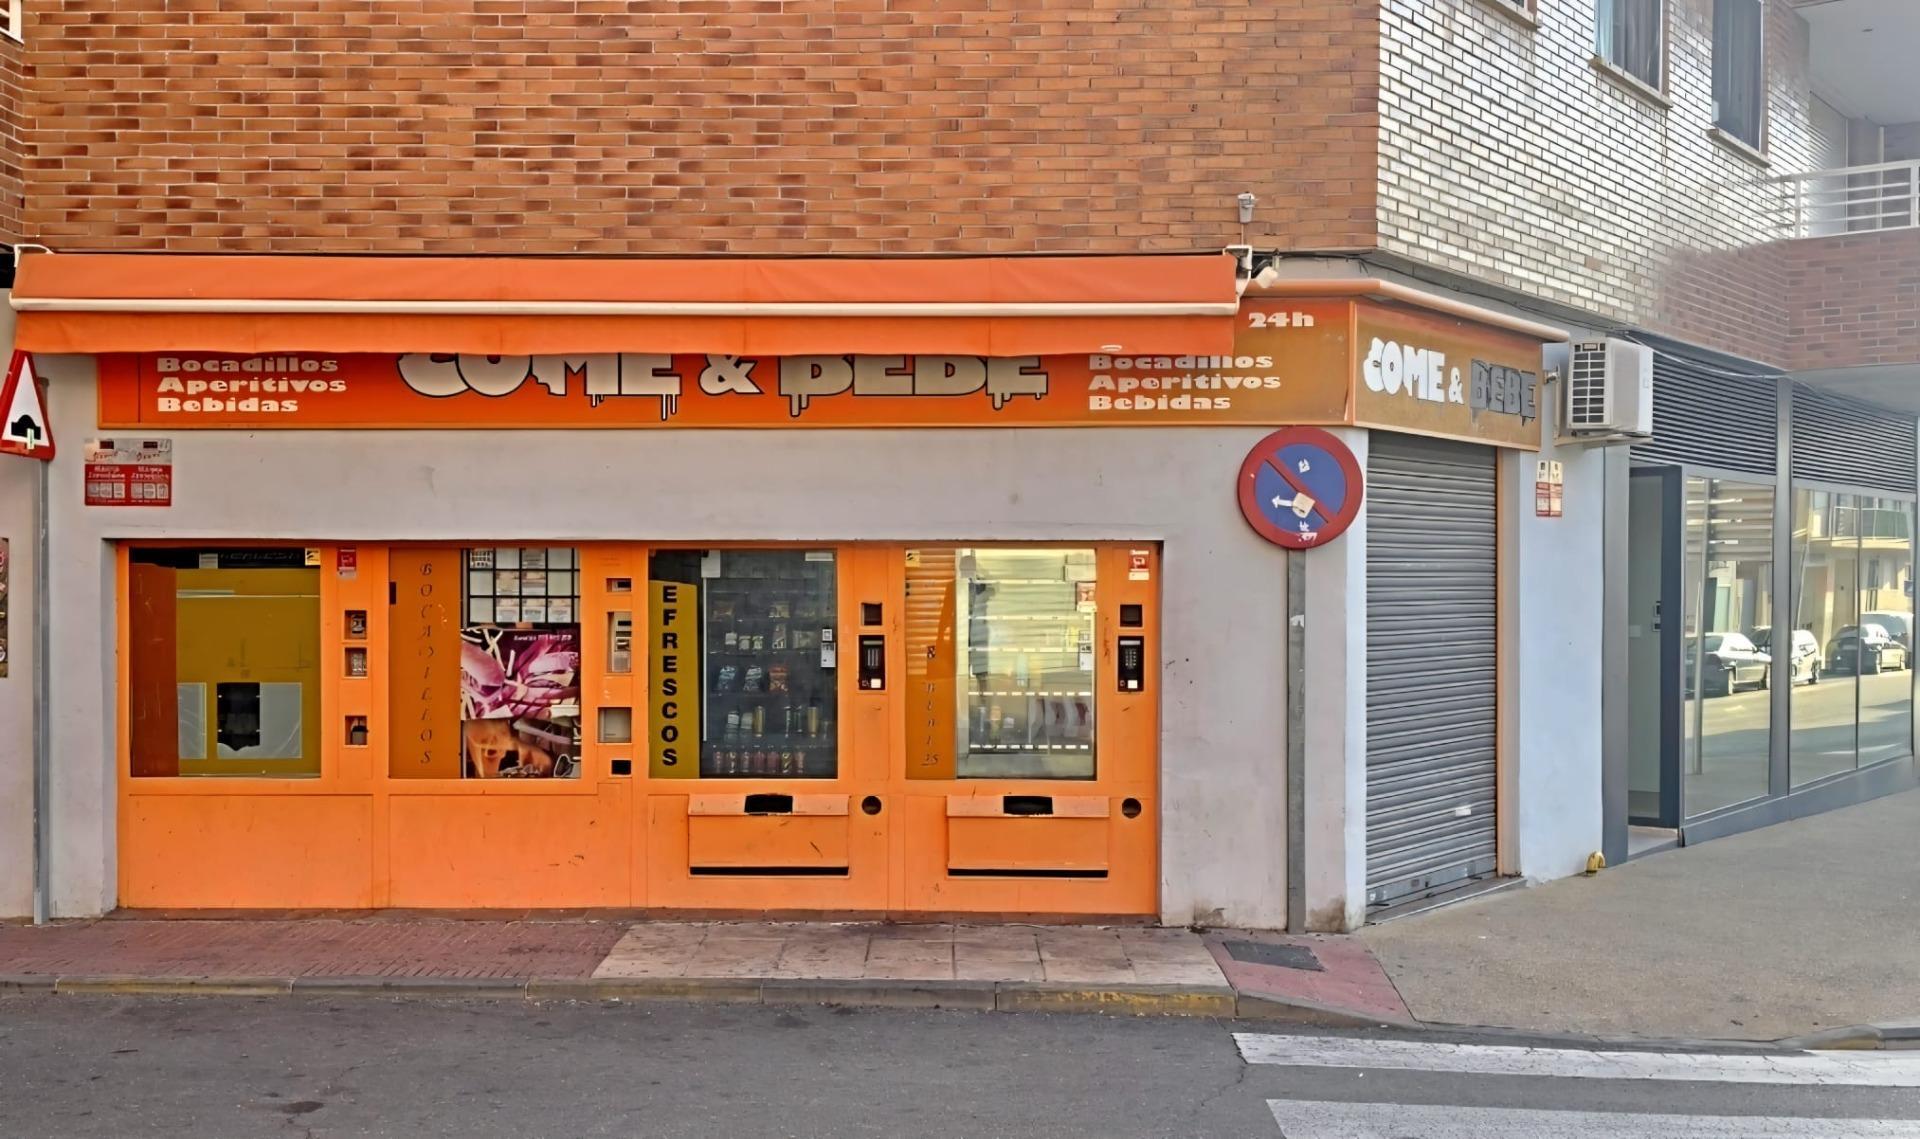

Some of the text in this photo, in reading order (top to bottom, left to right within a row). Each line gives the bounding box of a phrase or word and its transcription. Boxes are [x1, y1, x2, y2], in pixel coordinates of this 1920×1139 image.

[1249, 312, 1314, 328] 24h
[157, 356, 338, 373] Bocadillos
[1089, 354, 1273, 370] Bocadillos
[157, 375, 348, 395] Aperitivos
[1088, 373, 1281, 393] Aperitivos
[1362, 336, 1446, 404] COME
[1471, 357, 1537, 421] BEBE
[157, 396, 299, 413] Bebidas
[1089, 394, 1231, 411] Bebidas
[661, 585, 679, 766] EFRESCOS
